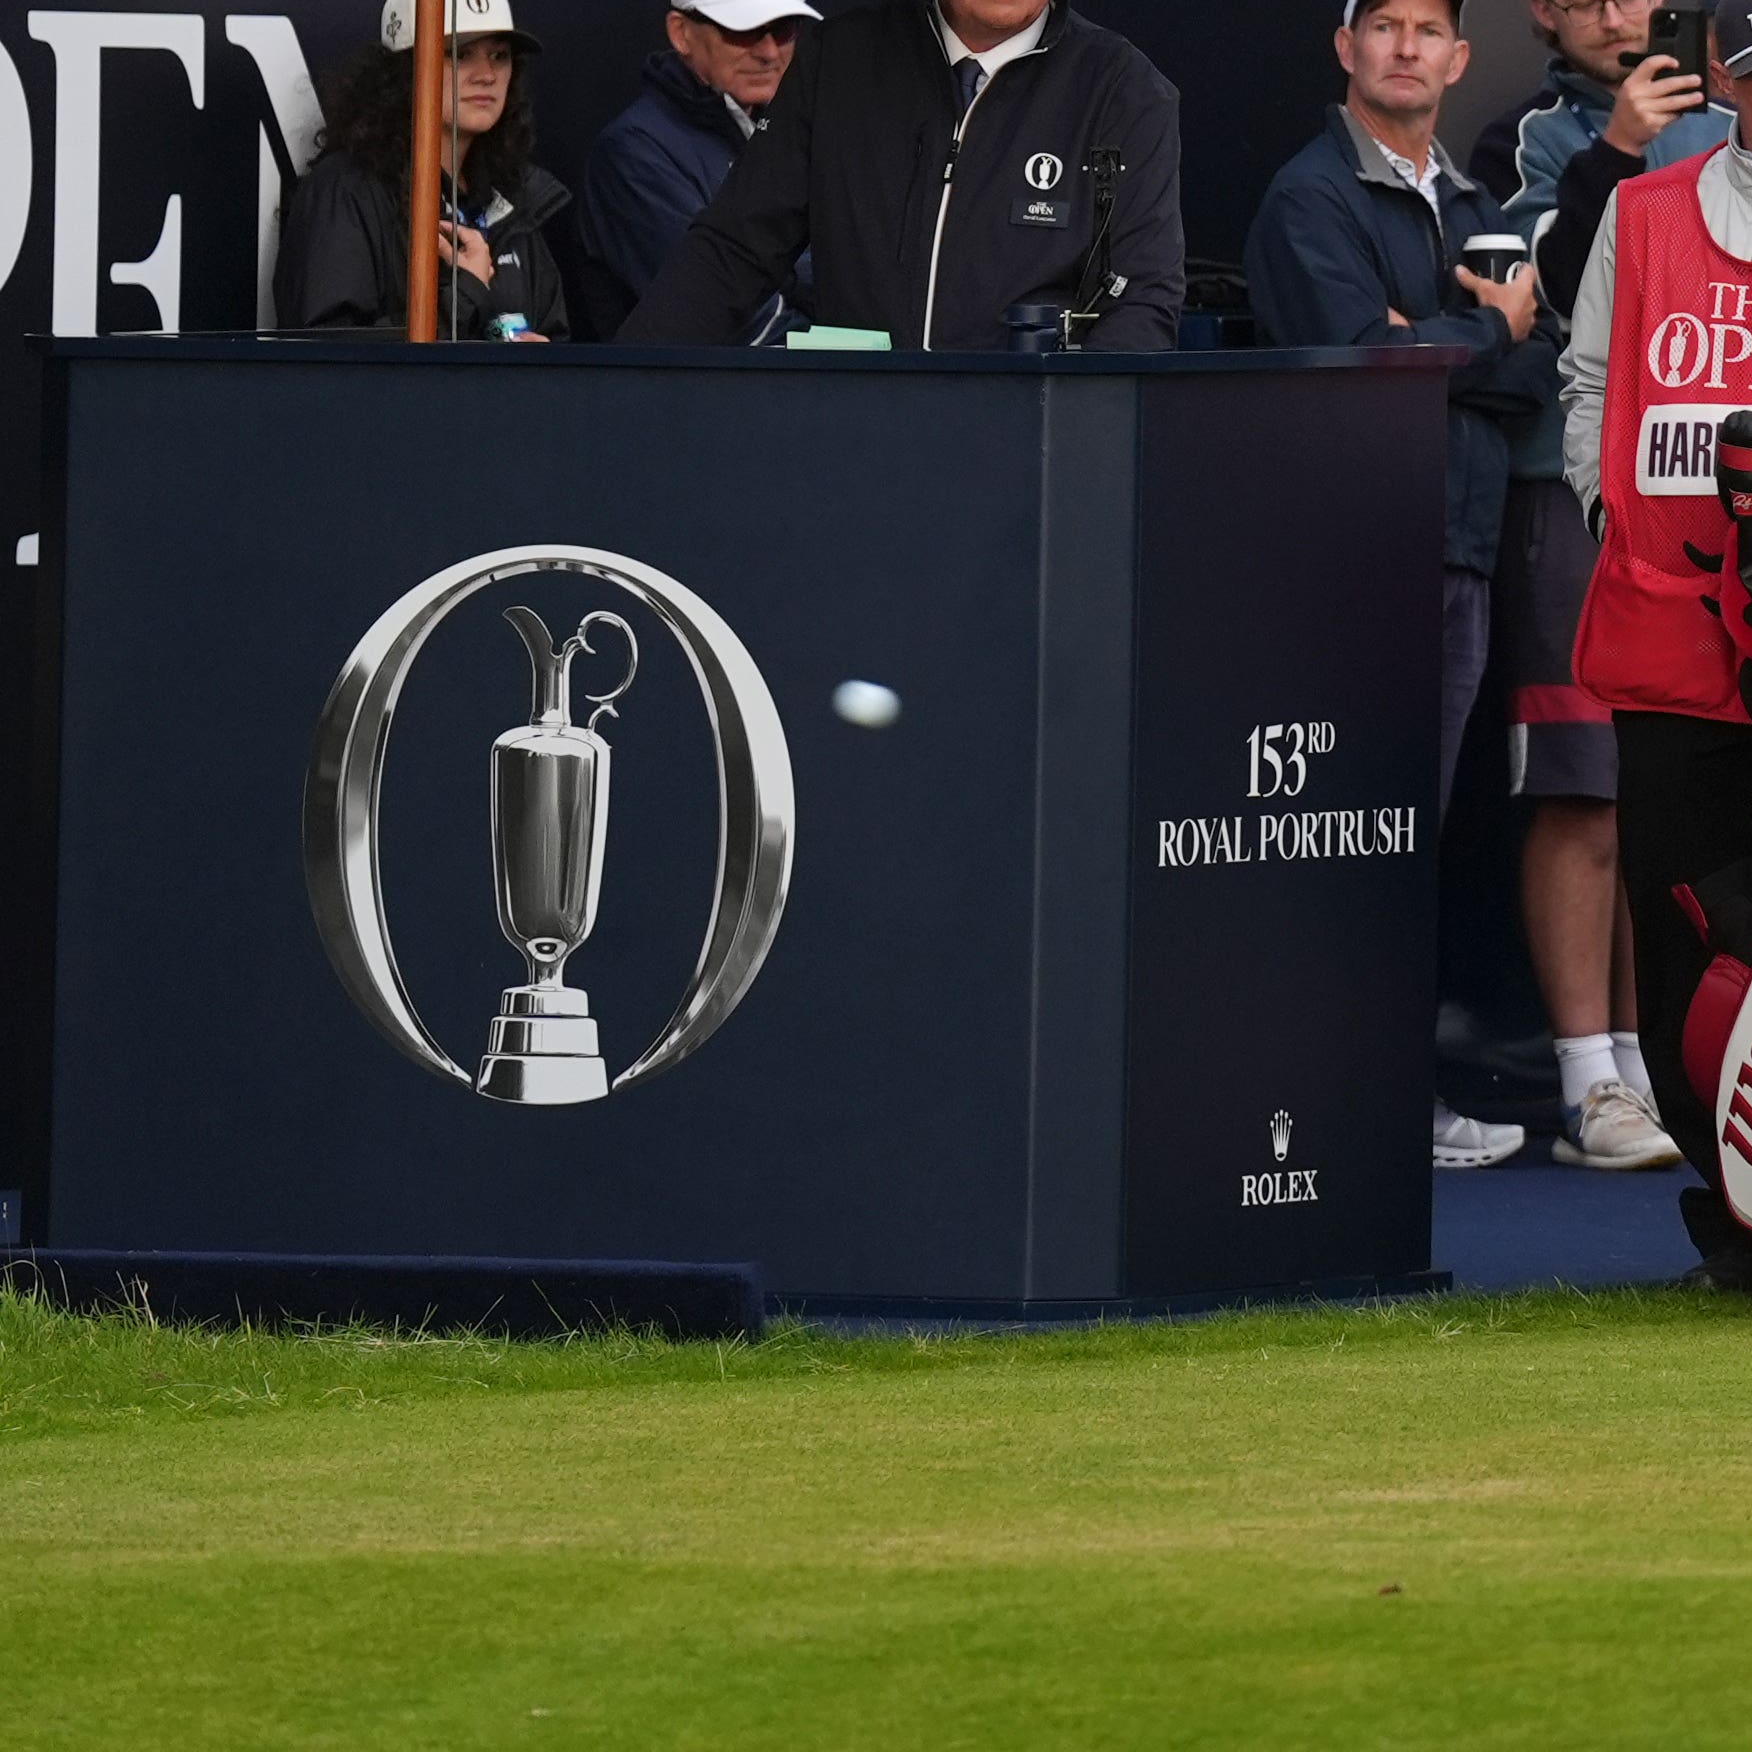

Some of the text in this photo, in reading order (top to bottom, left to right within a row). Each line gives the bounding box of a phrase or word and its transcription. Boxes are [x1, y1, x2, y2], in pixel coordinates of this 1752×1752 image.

[1158, 806, 1417, 868] ROYAL PORTRUSH
[1240, 1169, 1319, 1207] ROLEX
